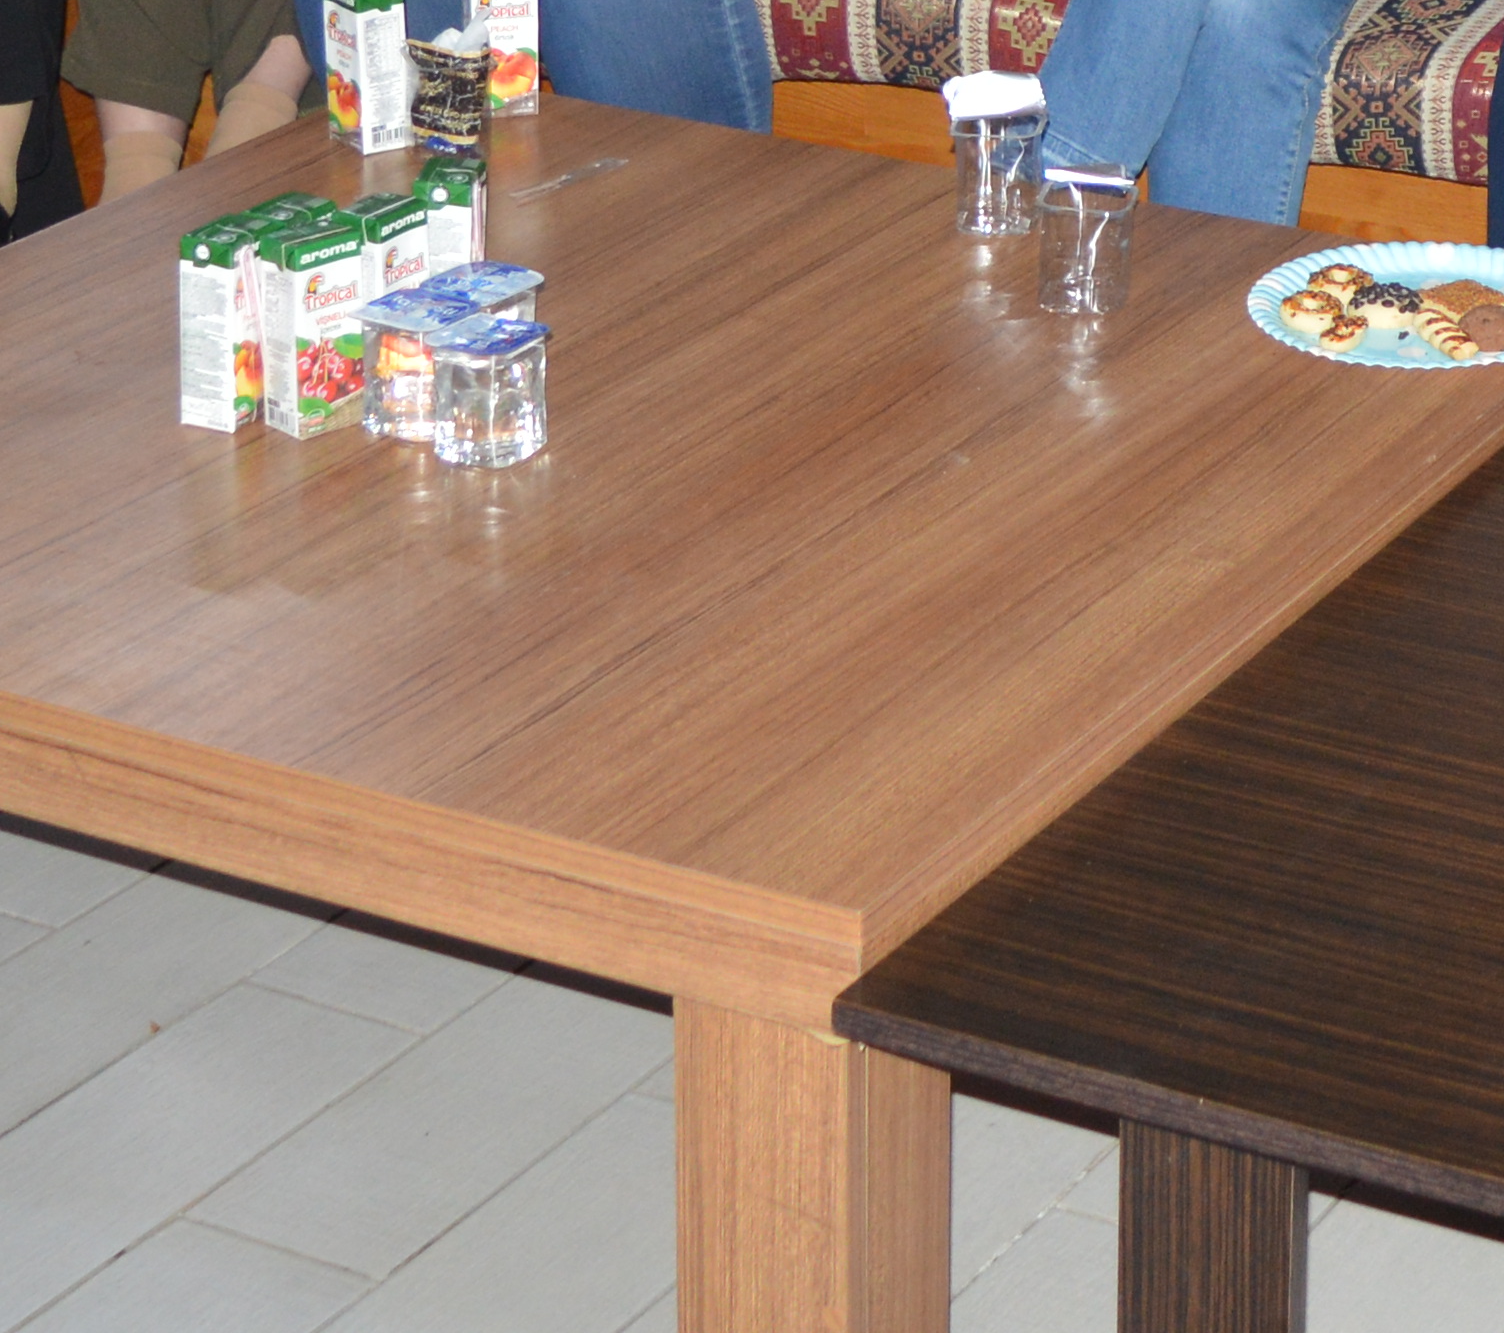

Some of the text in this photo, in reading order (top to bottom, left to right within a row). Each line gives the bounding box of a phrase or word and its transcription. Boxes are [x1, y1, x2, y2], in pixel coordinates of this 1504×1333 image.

[380, 210, 426, 237] aroma
[299, 239, 358, 265] aroma
[384, 252, 425, 286] Tropical
[303, 280, 358, 311] Tropical
